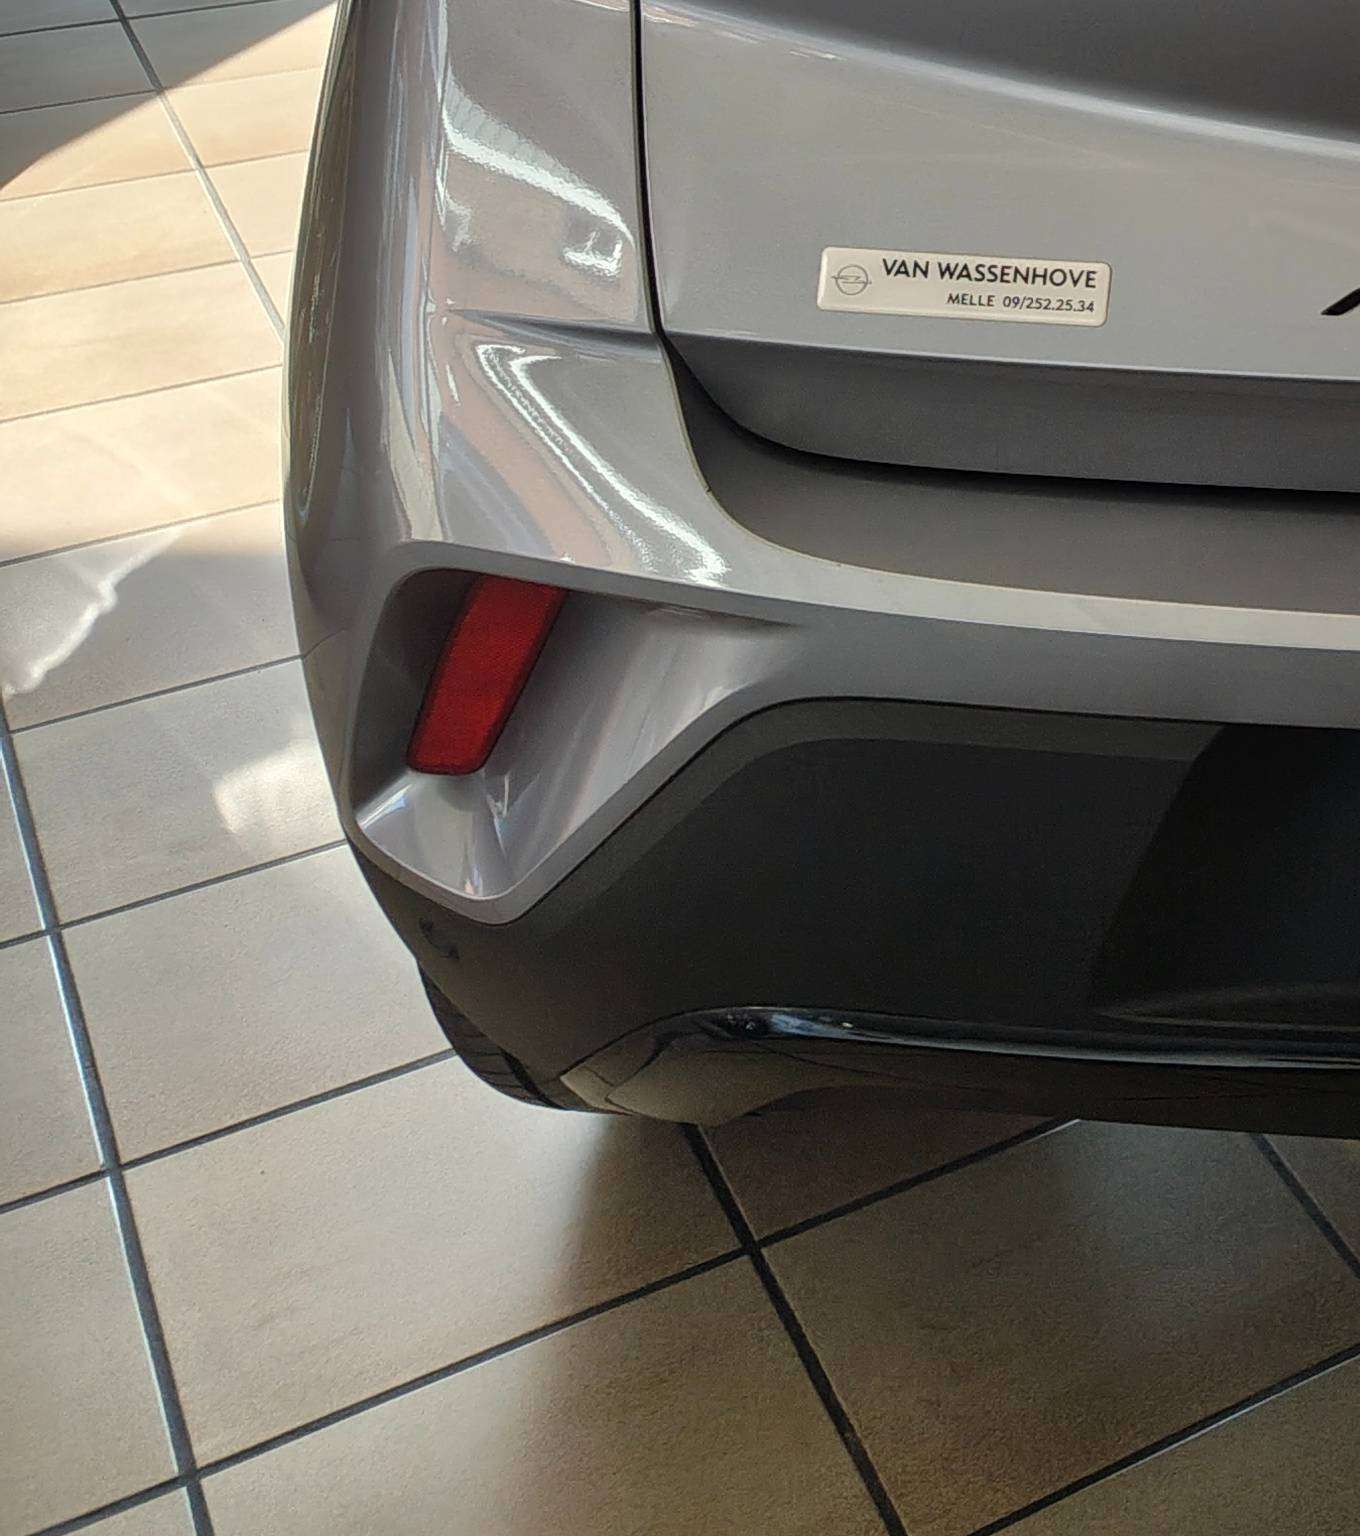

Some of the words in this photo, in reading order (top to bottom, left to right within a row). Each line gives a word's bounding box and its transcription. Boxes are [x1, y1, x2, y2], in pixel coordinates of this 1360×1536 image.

[882, 258, 929, 280] VAN
[937, 261, 1098, 289] WASSENHOVE
[946, 293, 996, 308] MELLE
[1002, 296, 1096, 314] 09/252.25.34
